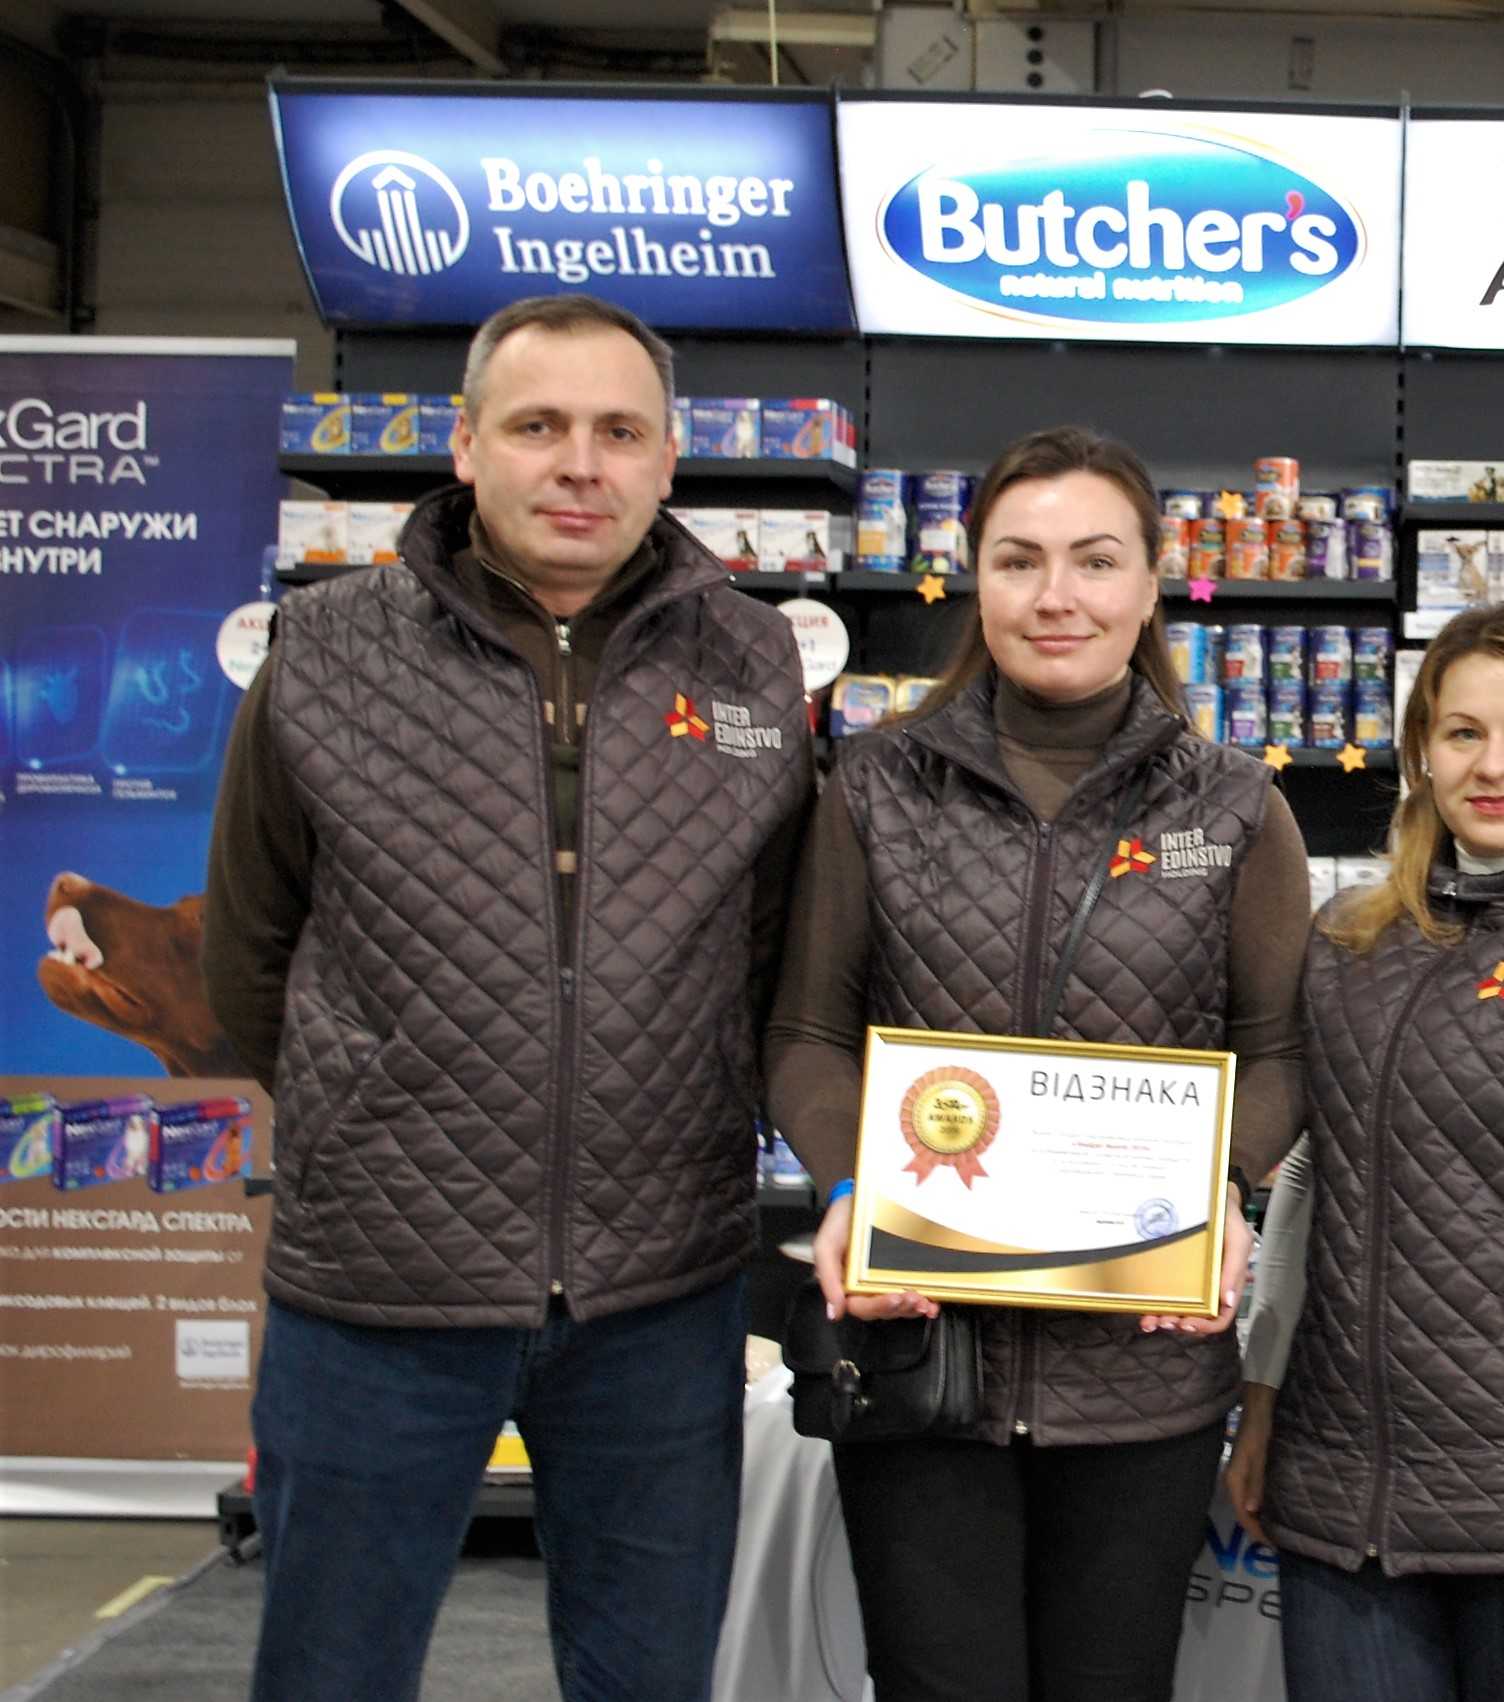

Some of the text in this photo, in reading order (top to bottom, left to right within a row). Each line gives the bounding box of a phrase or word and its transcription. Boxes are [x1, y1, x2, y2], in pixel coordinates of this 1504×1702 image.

[480, 156, 794, 227] Boehringer
[916, 178, 1339, 276] Butcher's
[493, 227, 776, 283] Ingelheim
[999, 271, 1244, 304] natural nutrition
[28, 510, 198, 541] СНАРУЖИ
[0, 546, 103, 575] НУТРИ
[1160, 828, 1204, 851] INTER
[1161, 845, 1232, 870] EDINSTVO
[1030, 1069, 1200, 1107] ВІДЗНАКА
[51, 1208, 160, 1233] НЕКСГАРД
[162, 1211, 253, 1233] СПЕКТРА
